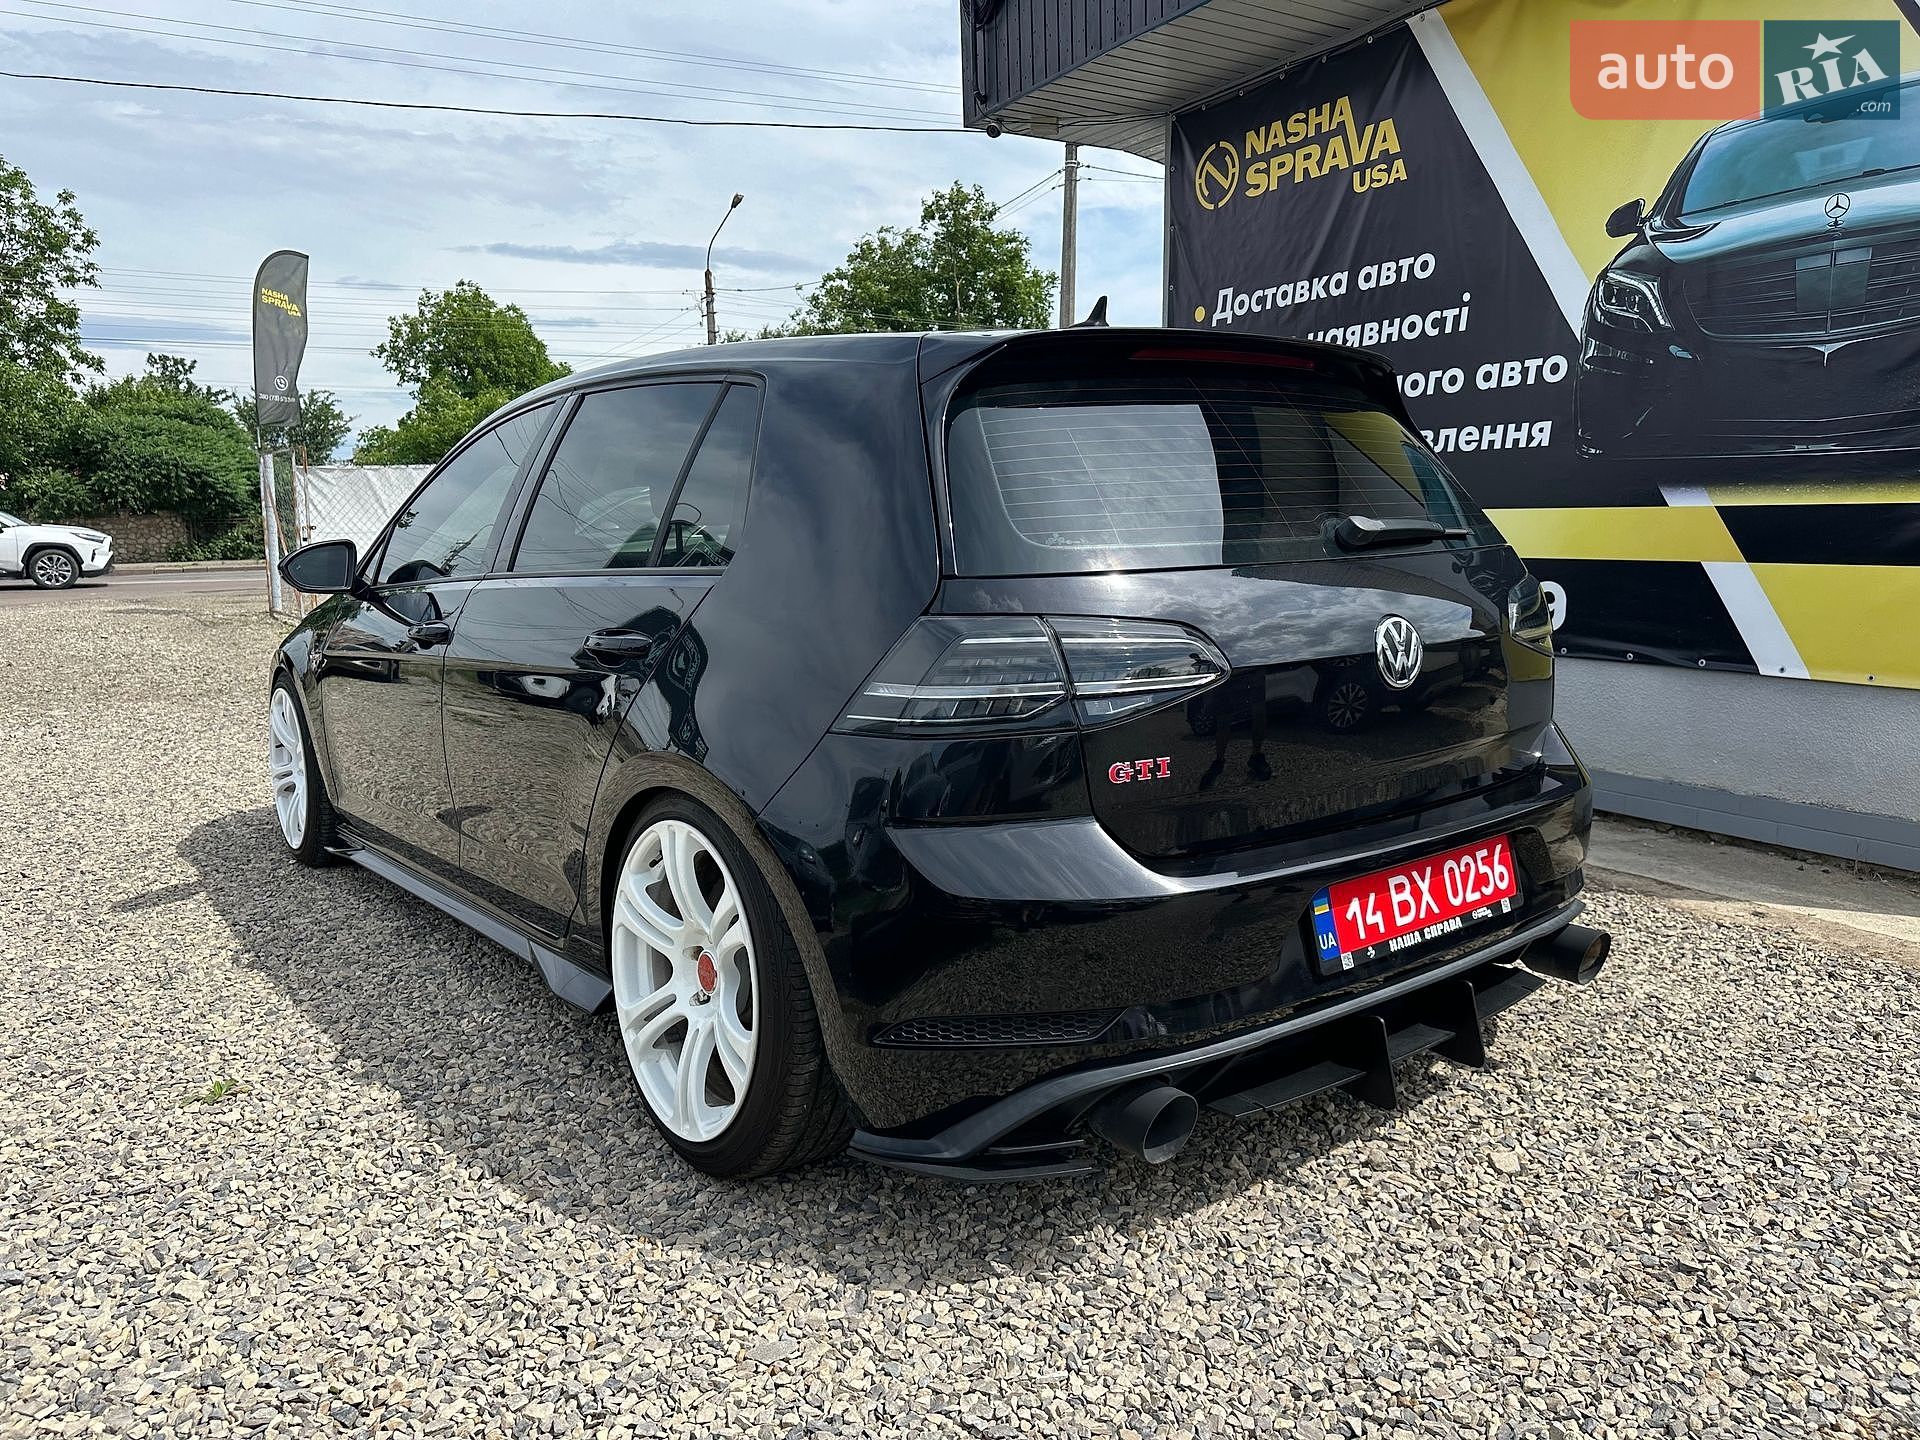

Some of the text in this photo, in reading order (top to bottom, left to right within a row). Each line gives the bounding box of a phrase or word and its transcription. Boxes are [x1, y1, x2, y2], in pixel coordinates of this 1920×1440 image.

[1245, 96, 1351, 159] NASHA
[1244, 117, 1401, 197] SPRAVA
[1352, 158, 1408, 194] USA
[261, 287, 289, 301] NASHA
[261, 294, 300, 312] SPRAVA
[1211, 252, 1436, 327] Доставка авто
[1475, 354, 1569, 391] авто
[1108, 756, 1171, 784] GTI
[1345, 844, 1510, 940] 14 BX 0256
[1318, 931, 1338, 950] UA
[1388, 916, 1463, 953] НАША СПРАВА
